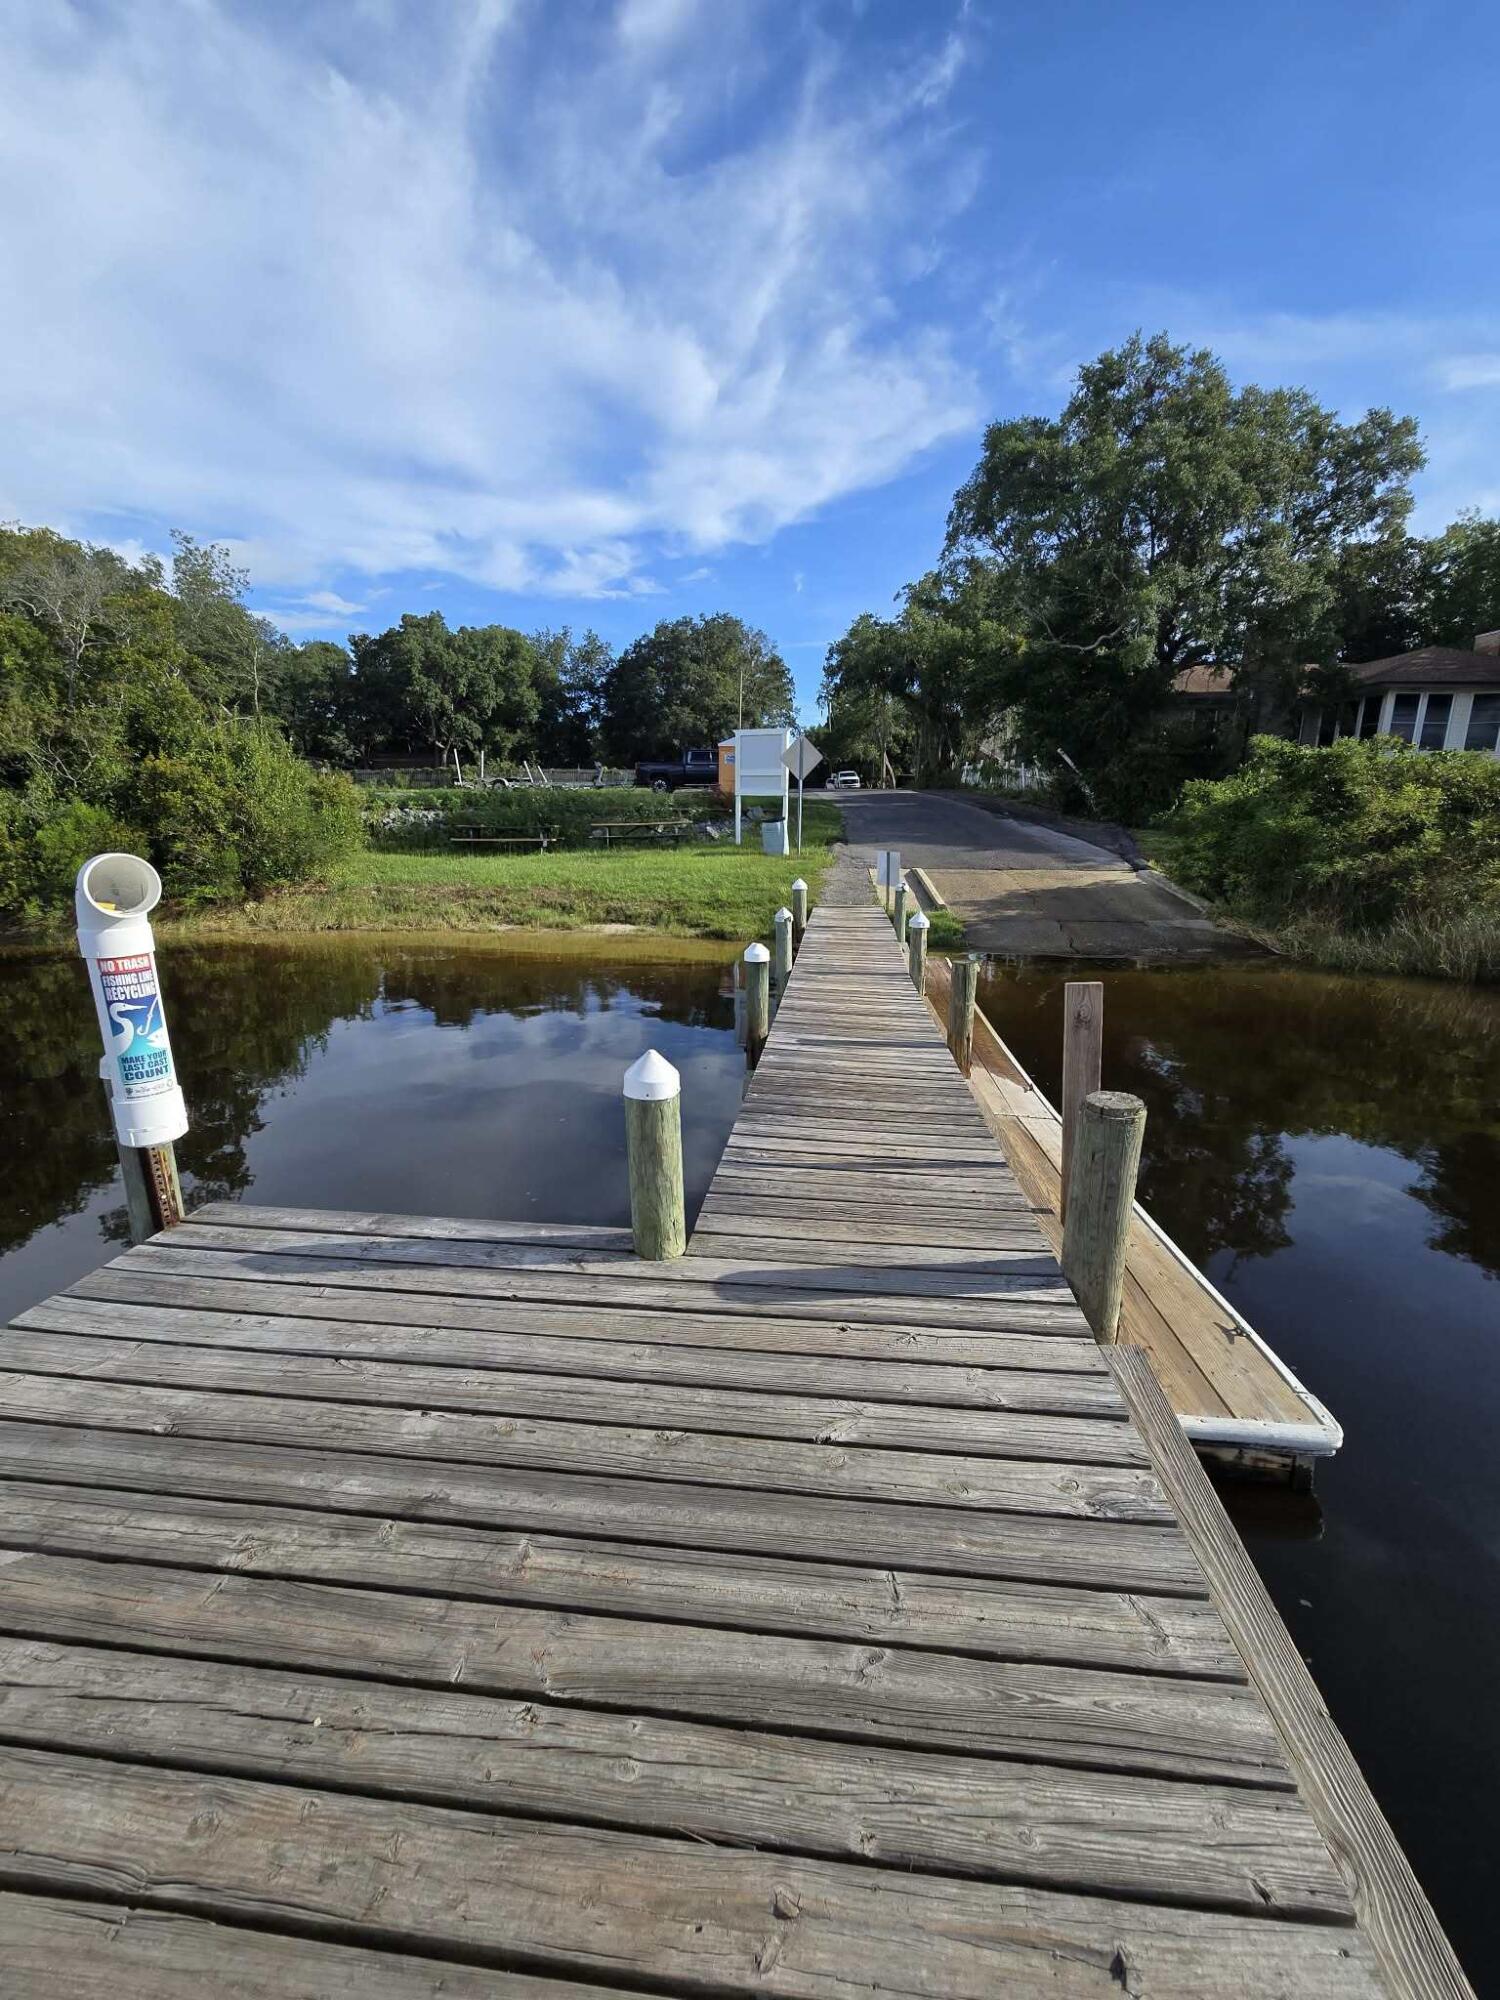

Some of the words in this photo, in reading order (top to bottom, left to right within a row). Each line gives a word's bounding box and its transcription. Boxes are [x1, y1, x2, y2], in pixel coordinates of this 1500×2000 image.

[100, 960, 115, 973] NO
[116, 955, 150, 971] TRASH
[102, 972, 138, 987] FISHING
[138, 969, 154, 982] LINE
[104, 980, 156, 1001] RECYCLING
[121, 1055, 145, 1064] MAKE
[147, 1049, 167, 1060] YOUR
[123, 1062, 145, 1072] LAST
[147, 1057, 168, 1068] CAST
[124, 1064, 169, 1080] COUNT
